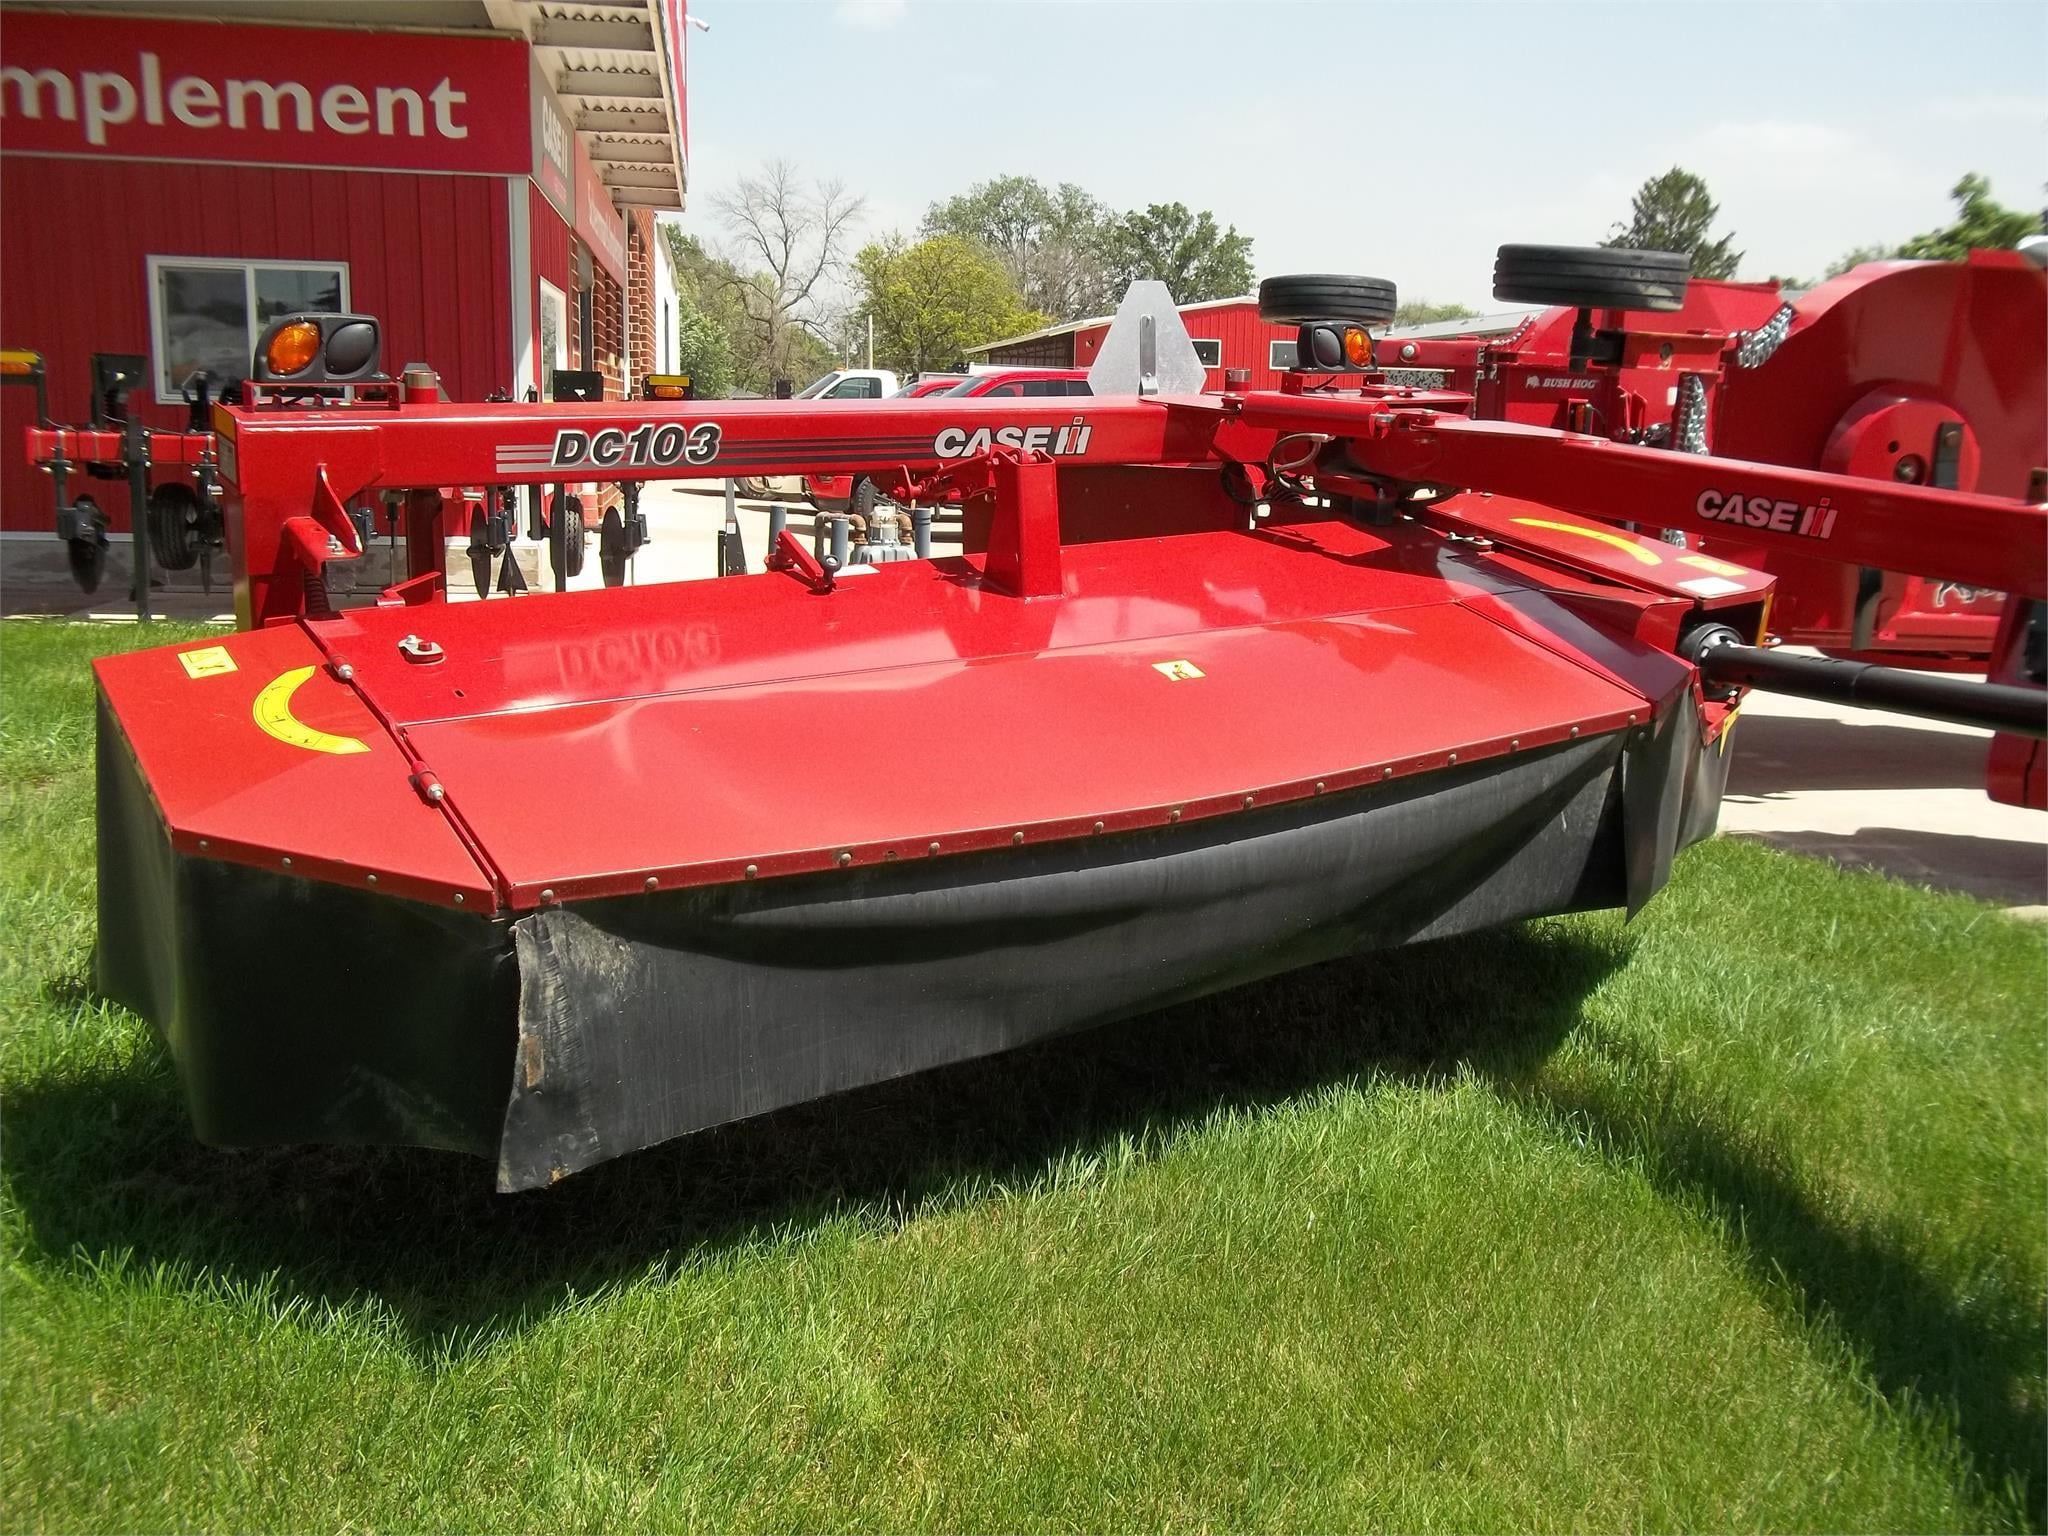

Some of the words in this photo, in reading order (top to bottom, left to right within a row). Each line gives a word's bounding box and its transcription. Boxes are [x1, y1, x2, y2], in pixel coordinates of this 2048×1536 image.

[0, 51, 469, 146] mplement
[1542, 377, 1571, 388] BUSH
[1571, 378, 1597, 389] HOG
[551, 422, 722, 467] DC103
[934, 426, 1052, 458] CASE
[1696, 489, 1798, 532] CASE
